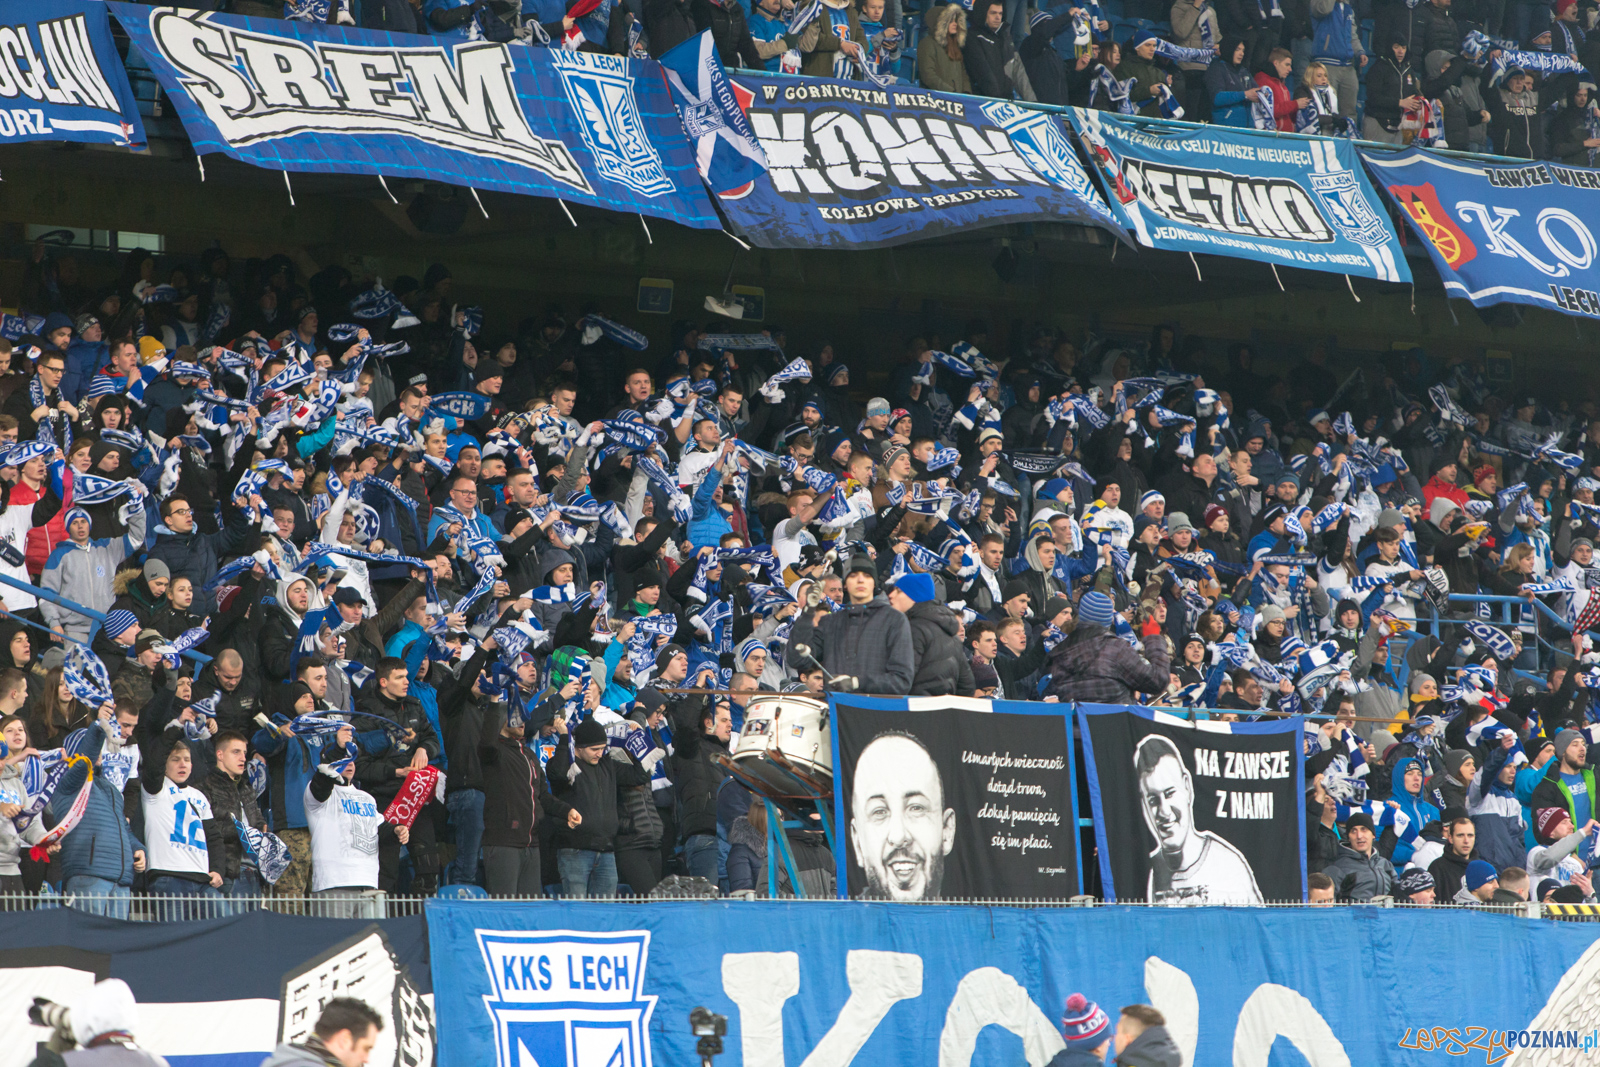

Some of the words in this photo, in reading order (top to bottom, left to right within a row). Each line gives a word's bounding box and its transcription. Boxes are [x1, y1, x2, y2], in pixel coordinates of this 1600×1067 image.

[561, 49, 586, 67] KKS
[593, 54, 624, 74] LECH
[705, 55, 722, 82] KKS
[150, 5, 597, 197] ŚREM
[762, 86, 777, 99] W
[785, 82, 888, 106] GÓRNICZYM
[894, 93, 964, 117] MIEŚCIE
[750, 111, 1050, 194] KONIN
[1181, 140, 1210, 154] CELU
[1212, 141, 1256, 161] ZAWSZE
[1257, 147, 1312, 168] NIEUGIĘCI
[1484, 164, 1553, 189] ZAWSZE
[1550, 164, 1600, 190] WIER
[818, 198, 920, 220] KOLEJOWA
[1153, 226, 1209, 243] JEDNEMU
[1293, 249, 1311, 263] AŻ
[1310, 253, 1327, 263] DO
[1328, 251, 1371, 267] ŚMIERCI
[962, 750, 1013, 774] Umarłych
[1194, 749, 1220, 778] NA
[1224, 751, 1291, 780] ZAWSZE
[987, 777, 1016, 797] dotąd
[977, 803, 1011, 823] dokąd
[1010, 807, 1060, 827] pamięcią
[1216, 790, 1226, 818] Z
[1231, 792, 1274, 820] NAMI
[991, 831, 1007, 850] się
[502, 955, 551, 991] KKS
[567, 955, 629, 991] LECH
